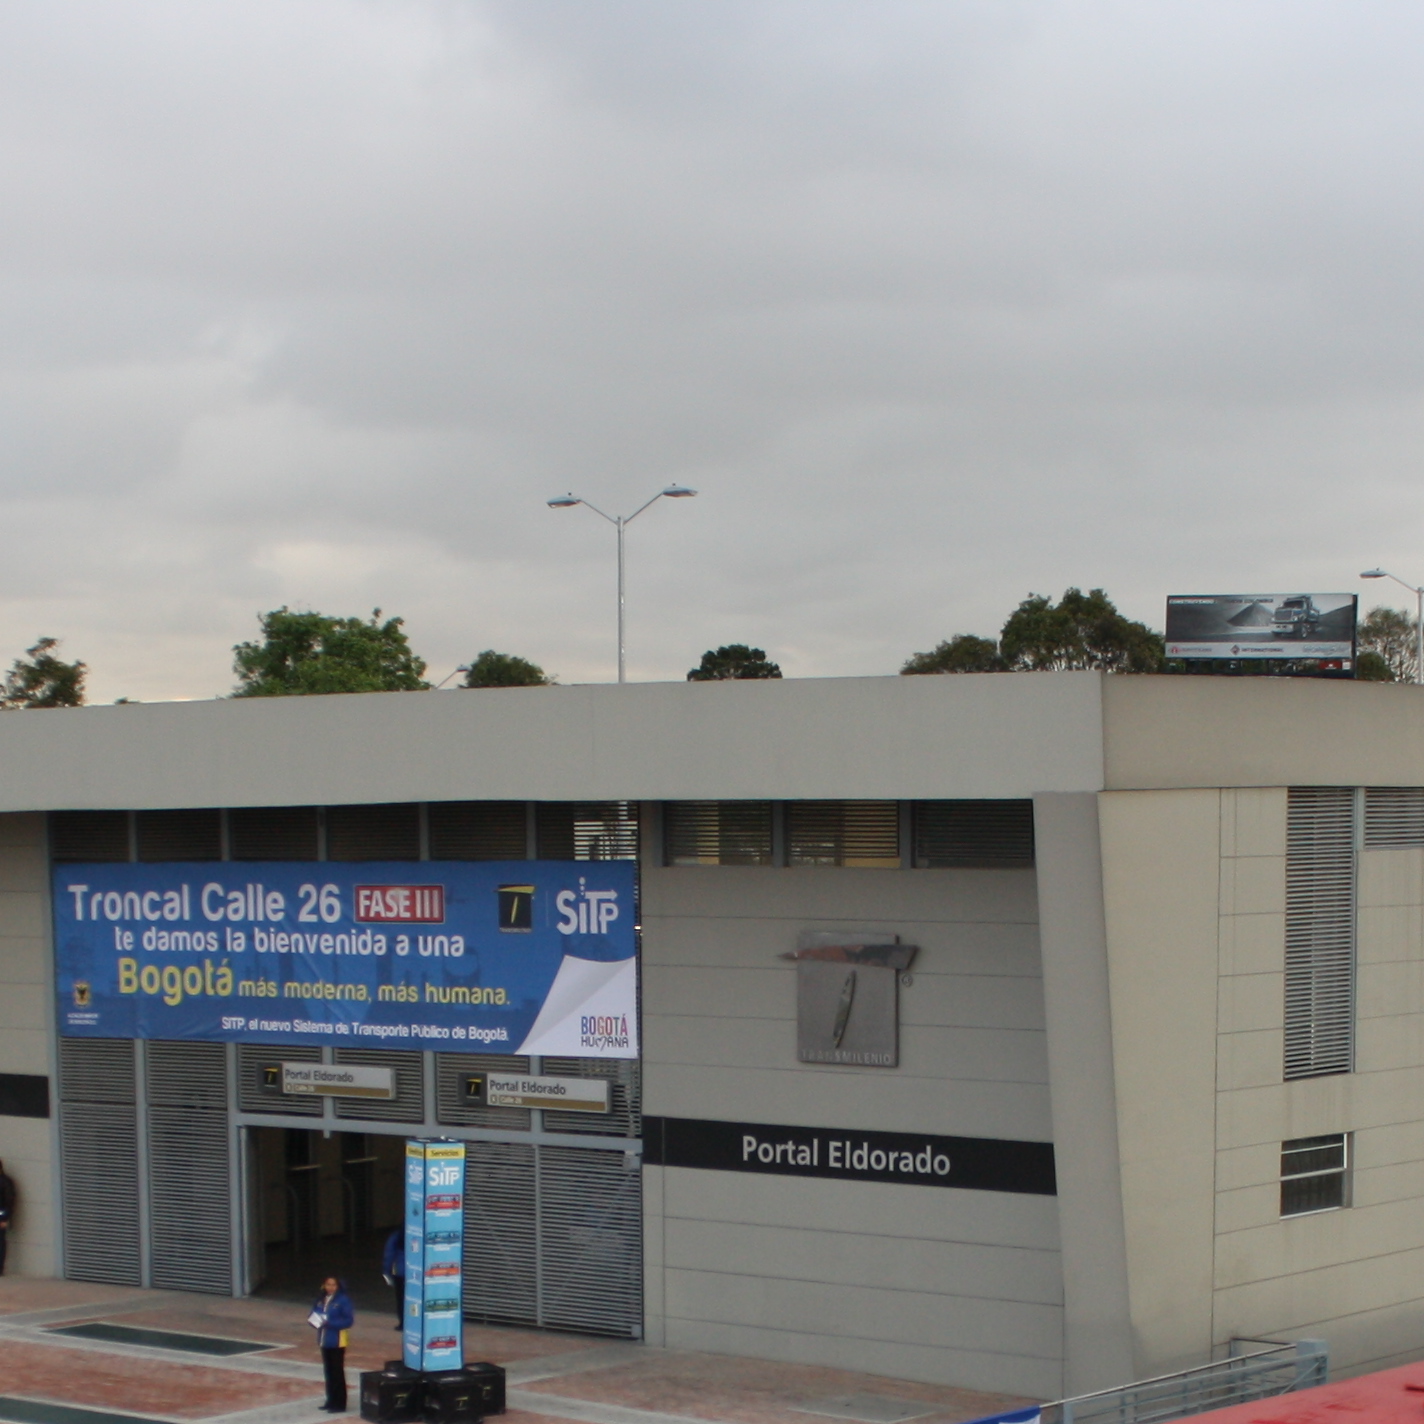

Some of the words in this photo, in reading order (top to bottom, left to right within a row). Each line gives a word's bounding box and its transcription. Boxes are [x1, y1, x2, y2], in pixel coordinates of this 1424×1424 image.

[67, 884, 190, 921] Troncal
[201, 882, 285, 921] Calle
[298, 883, 341, 923] 26
[359, 889, 410, 918] FASE
[115, 926, 134, 951] te
[142, 926, 218, 952] damos
[226, 927, 246, 952] la
[254, 927, 386, 956] bienvenida
[395, 936, 414, 956] a
[418, 935, 465, 957] una
[118, 957, 233, 1006] Bogotá
[238, 977, 278, 998] más
[283, 979, 372, 1002] moderna,
[378, 981, 418, 1002] más
[425, 982, 510, 1006] humana.
[260, 1021, 291, 1032] nuevo
[293, 1019, 333, 1034] Sistema
[336, 1021, 349, 1034] de
[351, 1021, 409, 1039] Transporte
[411, 1023, 450, 1039] Público
[452, 1025, 466, 1039] de
[581, 1013, 628, 1036] BOGOTÁ
[285, 1068, 311, 1080] Portal
[314, 1070, 354, 1083] Eldorado
[489, 1079, 518, 1092] Portal
[522, 1081, 566, 1095] Eldorado
[742, 1135, 819, 1167] Portal
[828, 1140, 951, 1176] Eldorado
